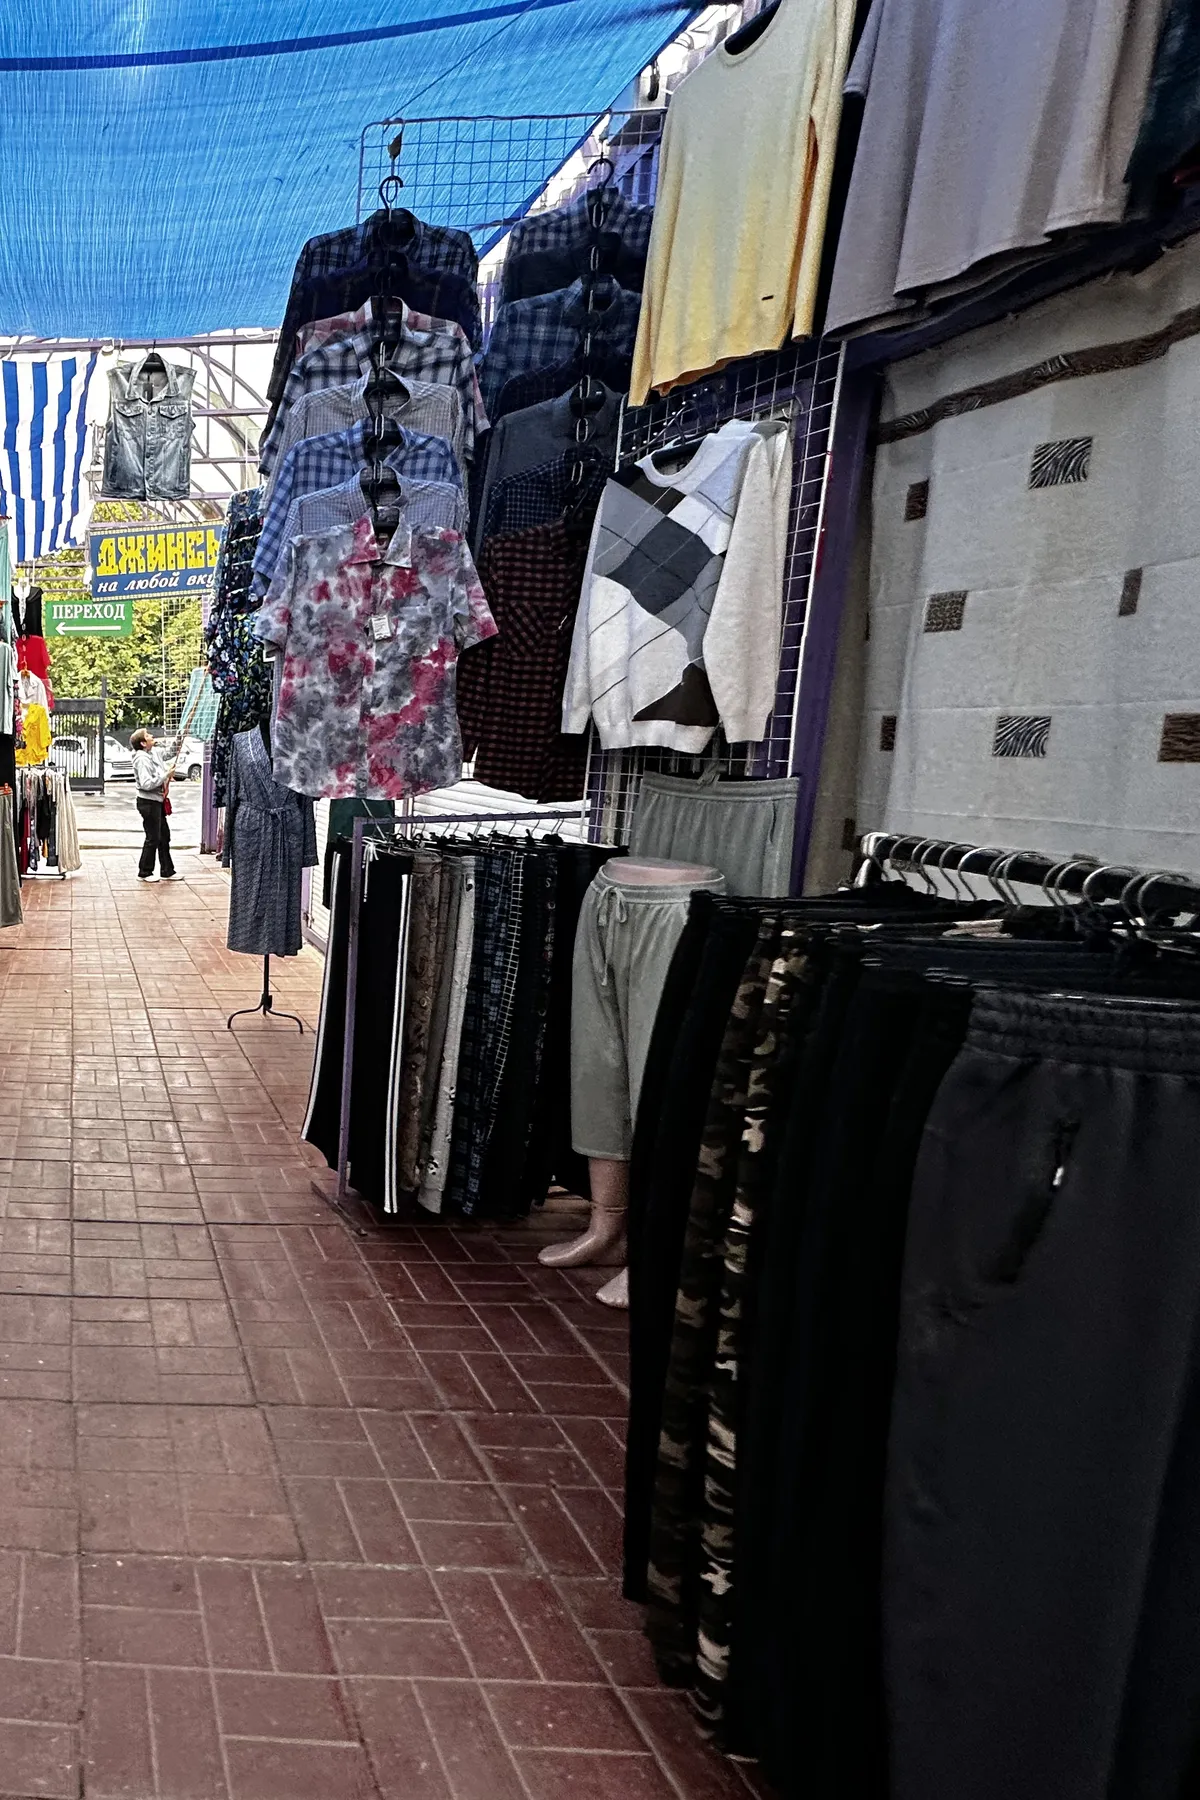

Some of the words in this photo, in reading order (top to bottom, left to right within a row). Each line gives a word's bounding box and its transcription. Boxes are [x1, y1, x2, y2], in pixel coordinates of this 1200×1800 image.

[97, 582, 118, 593] на
[124, 571, 181, 590] любой
[186, 573, 215, 588] вку
[52, 604, 125, 620] ПЕРЕХОД
